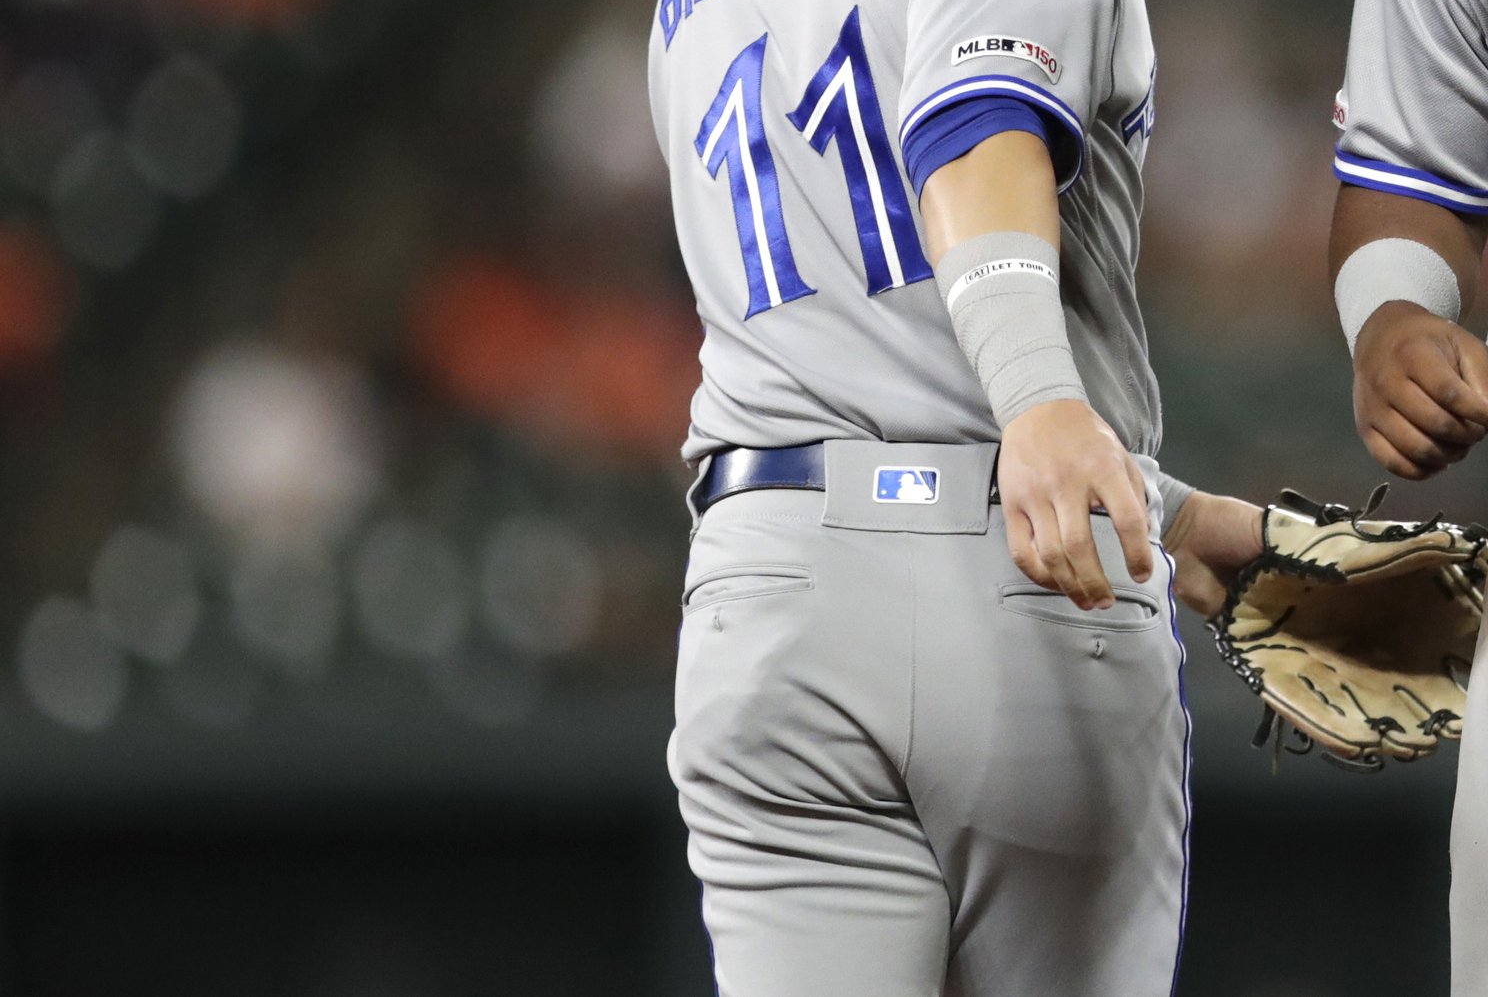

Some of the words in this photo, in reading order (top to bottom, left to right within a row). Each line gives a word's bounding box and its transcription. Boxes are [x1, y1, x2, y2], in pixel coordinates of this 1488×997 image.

[957, 38, 1001, 58] MLB
[1034, 46, 1057, 74] 150
[693, 4, 934, 321] 11
[991, 262, 1012, 271] LET
[1019, 262, 1044, 272] YOUR
